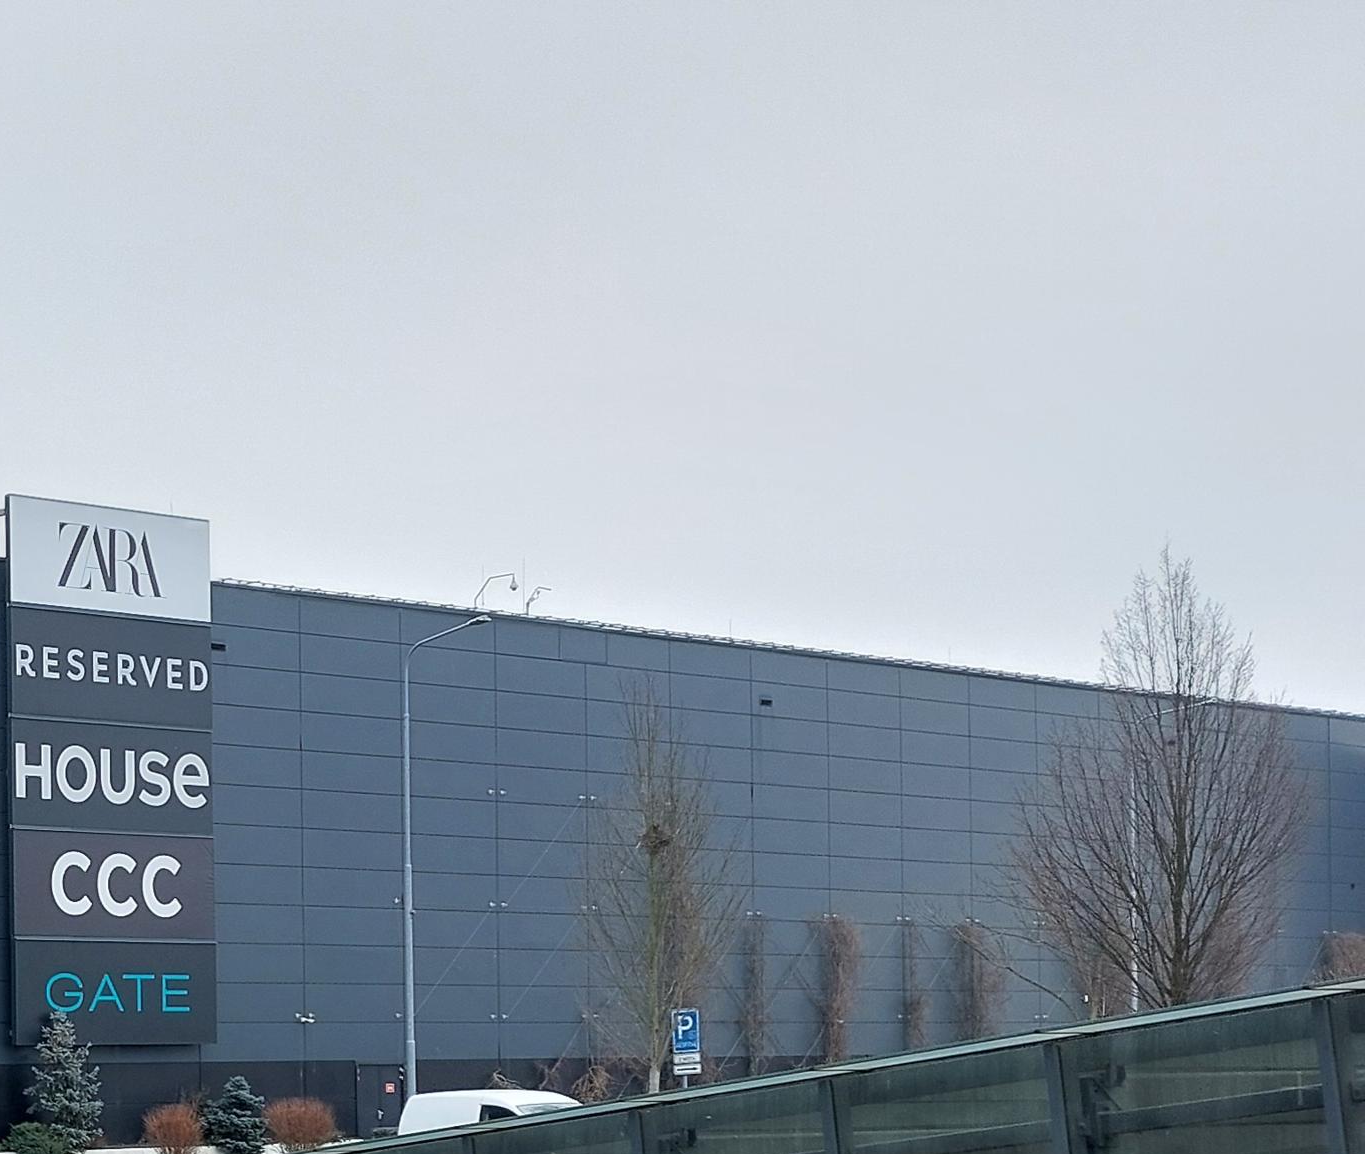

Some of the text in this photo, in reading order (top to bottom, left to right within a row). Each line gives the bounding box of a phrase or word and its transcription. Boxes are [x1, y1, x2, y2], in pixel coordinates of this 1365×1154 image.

[58, 520, 167, 600] ZARA
[16, 643, 208, 692] RESERVED
[51, 851, 183, 917] CCC
[45, 973, 191, 1013] GATE
[677, 1015, 693, 1040] P
